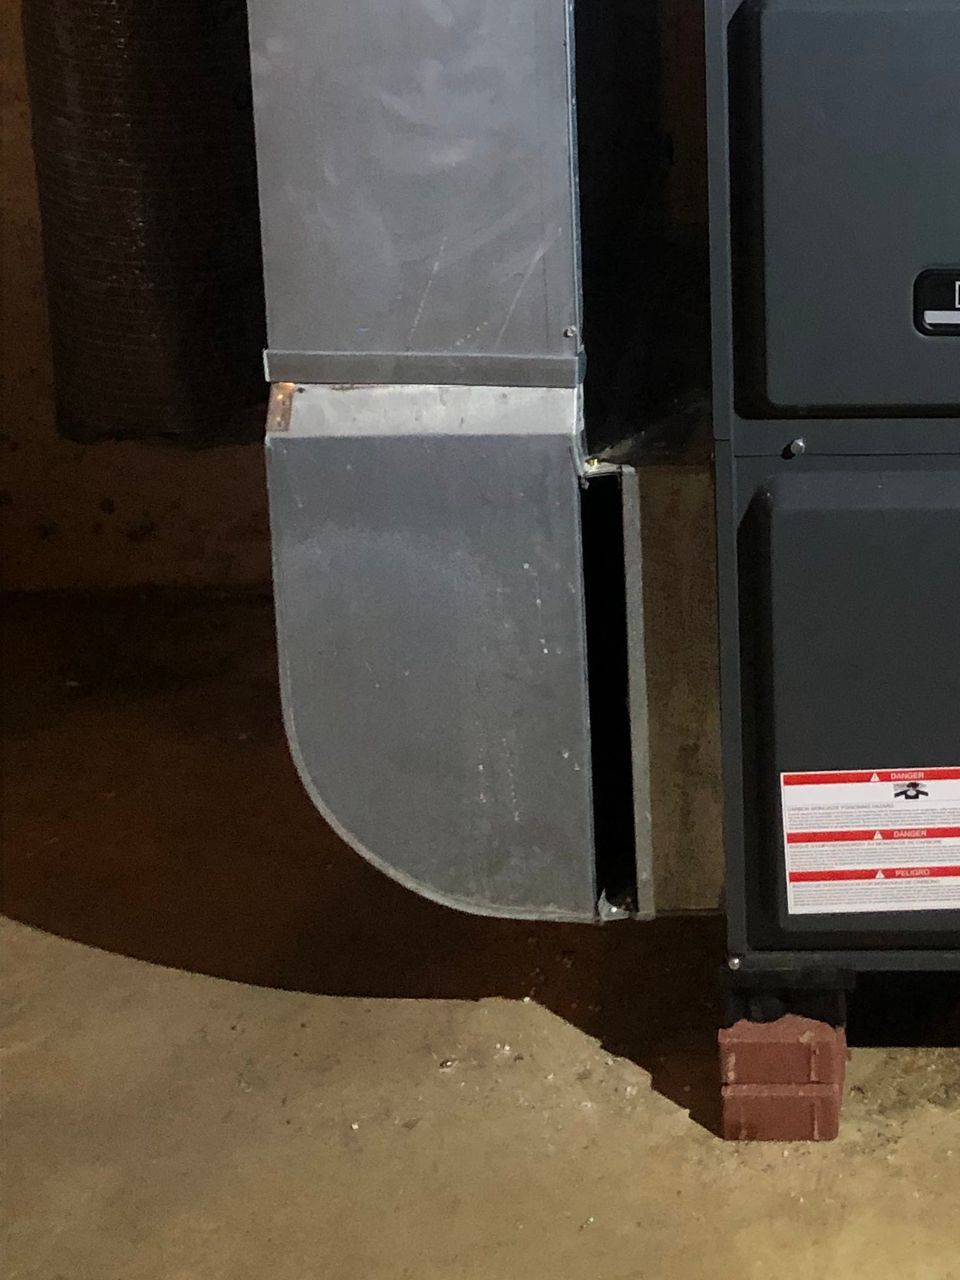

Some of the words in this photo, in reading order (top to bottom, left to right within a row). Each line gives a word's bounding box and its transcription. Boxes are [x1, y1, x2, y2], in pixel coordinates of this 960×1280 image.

[890, 771, 924, 780] DANGER
[893, 829, 927, 838] DANGER
[895, 869, 930, 877] PELIGRO
